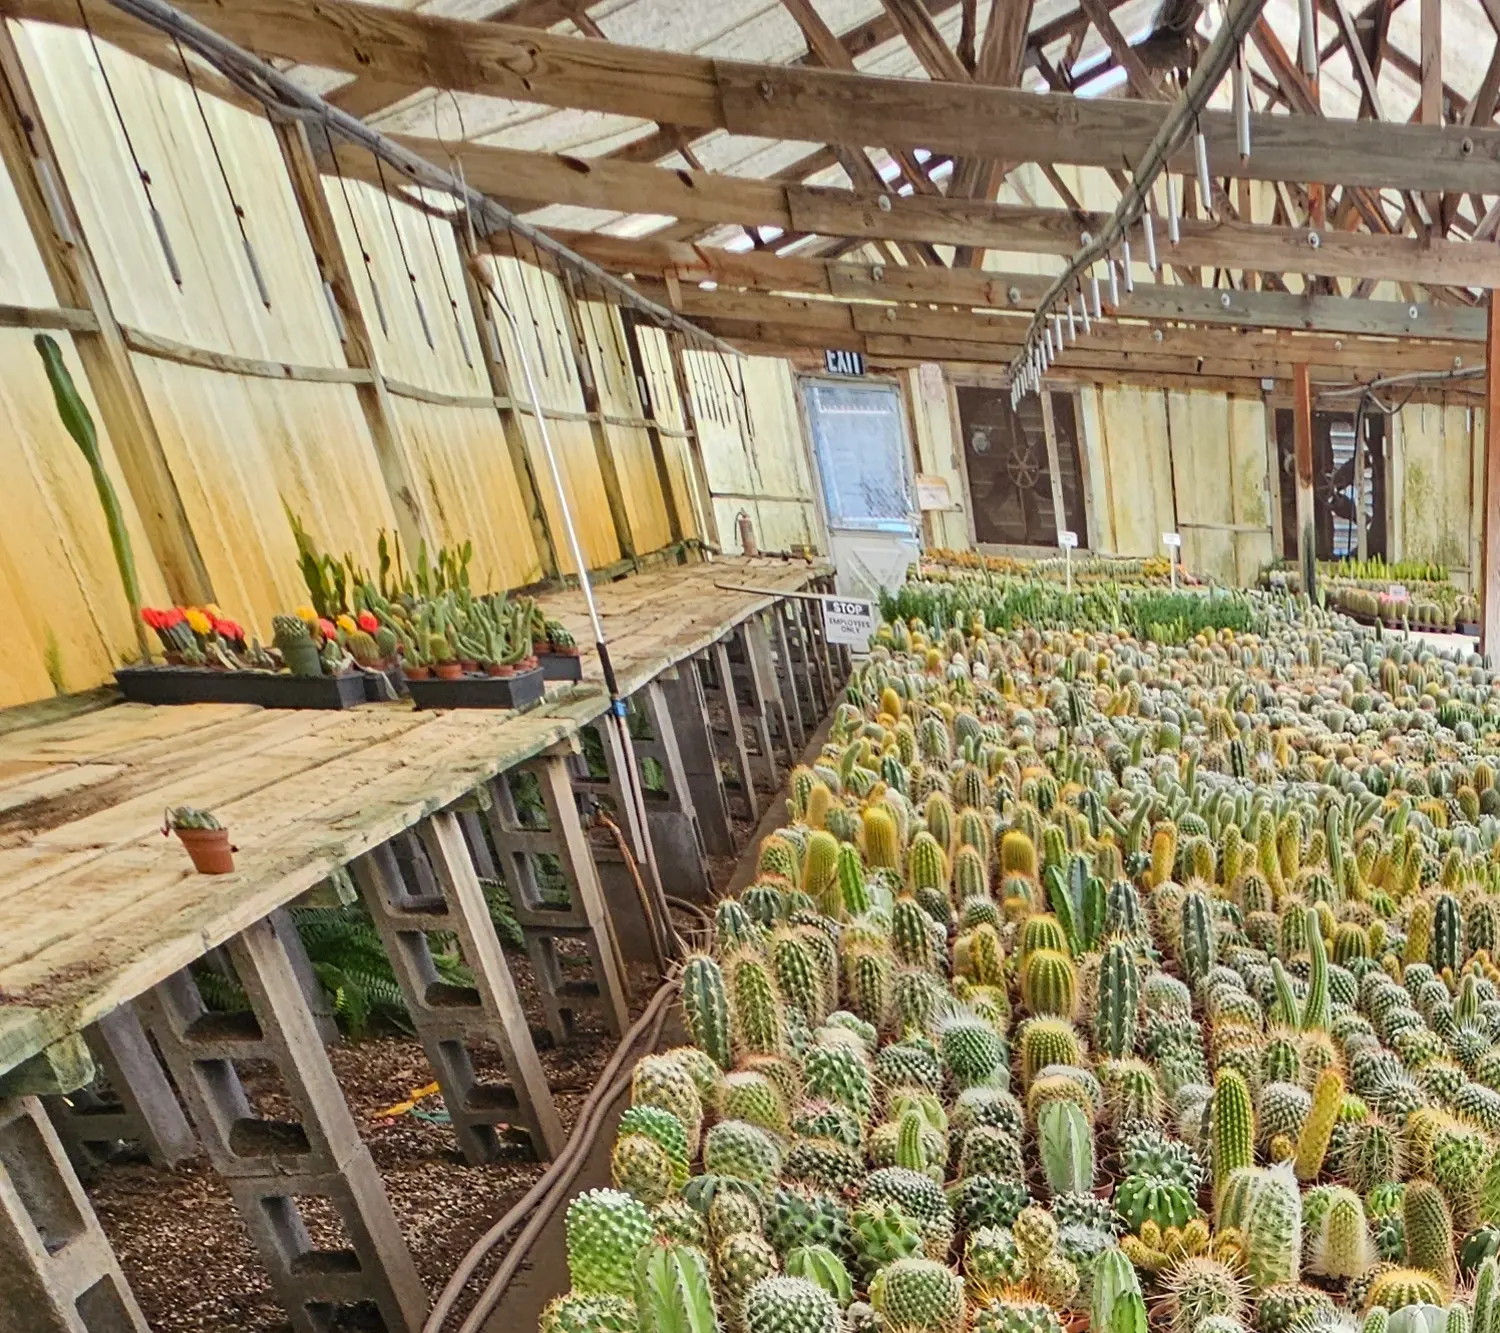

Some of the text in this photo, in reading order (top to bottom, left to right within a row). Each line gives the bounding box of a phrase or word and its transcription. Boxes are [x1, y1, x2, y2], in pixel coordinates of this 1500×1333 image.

[826, 350, 861, 374] EXIT
[833, 601, 862, 615] STOP
[829, 617, 870, 628] EMPLOYEES
[841, 626, 860, 634] ONLY
